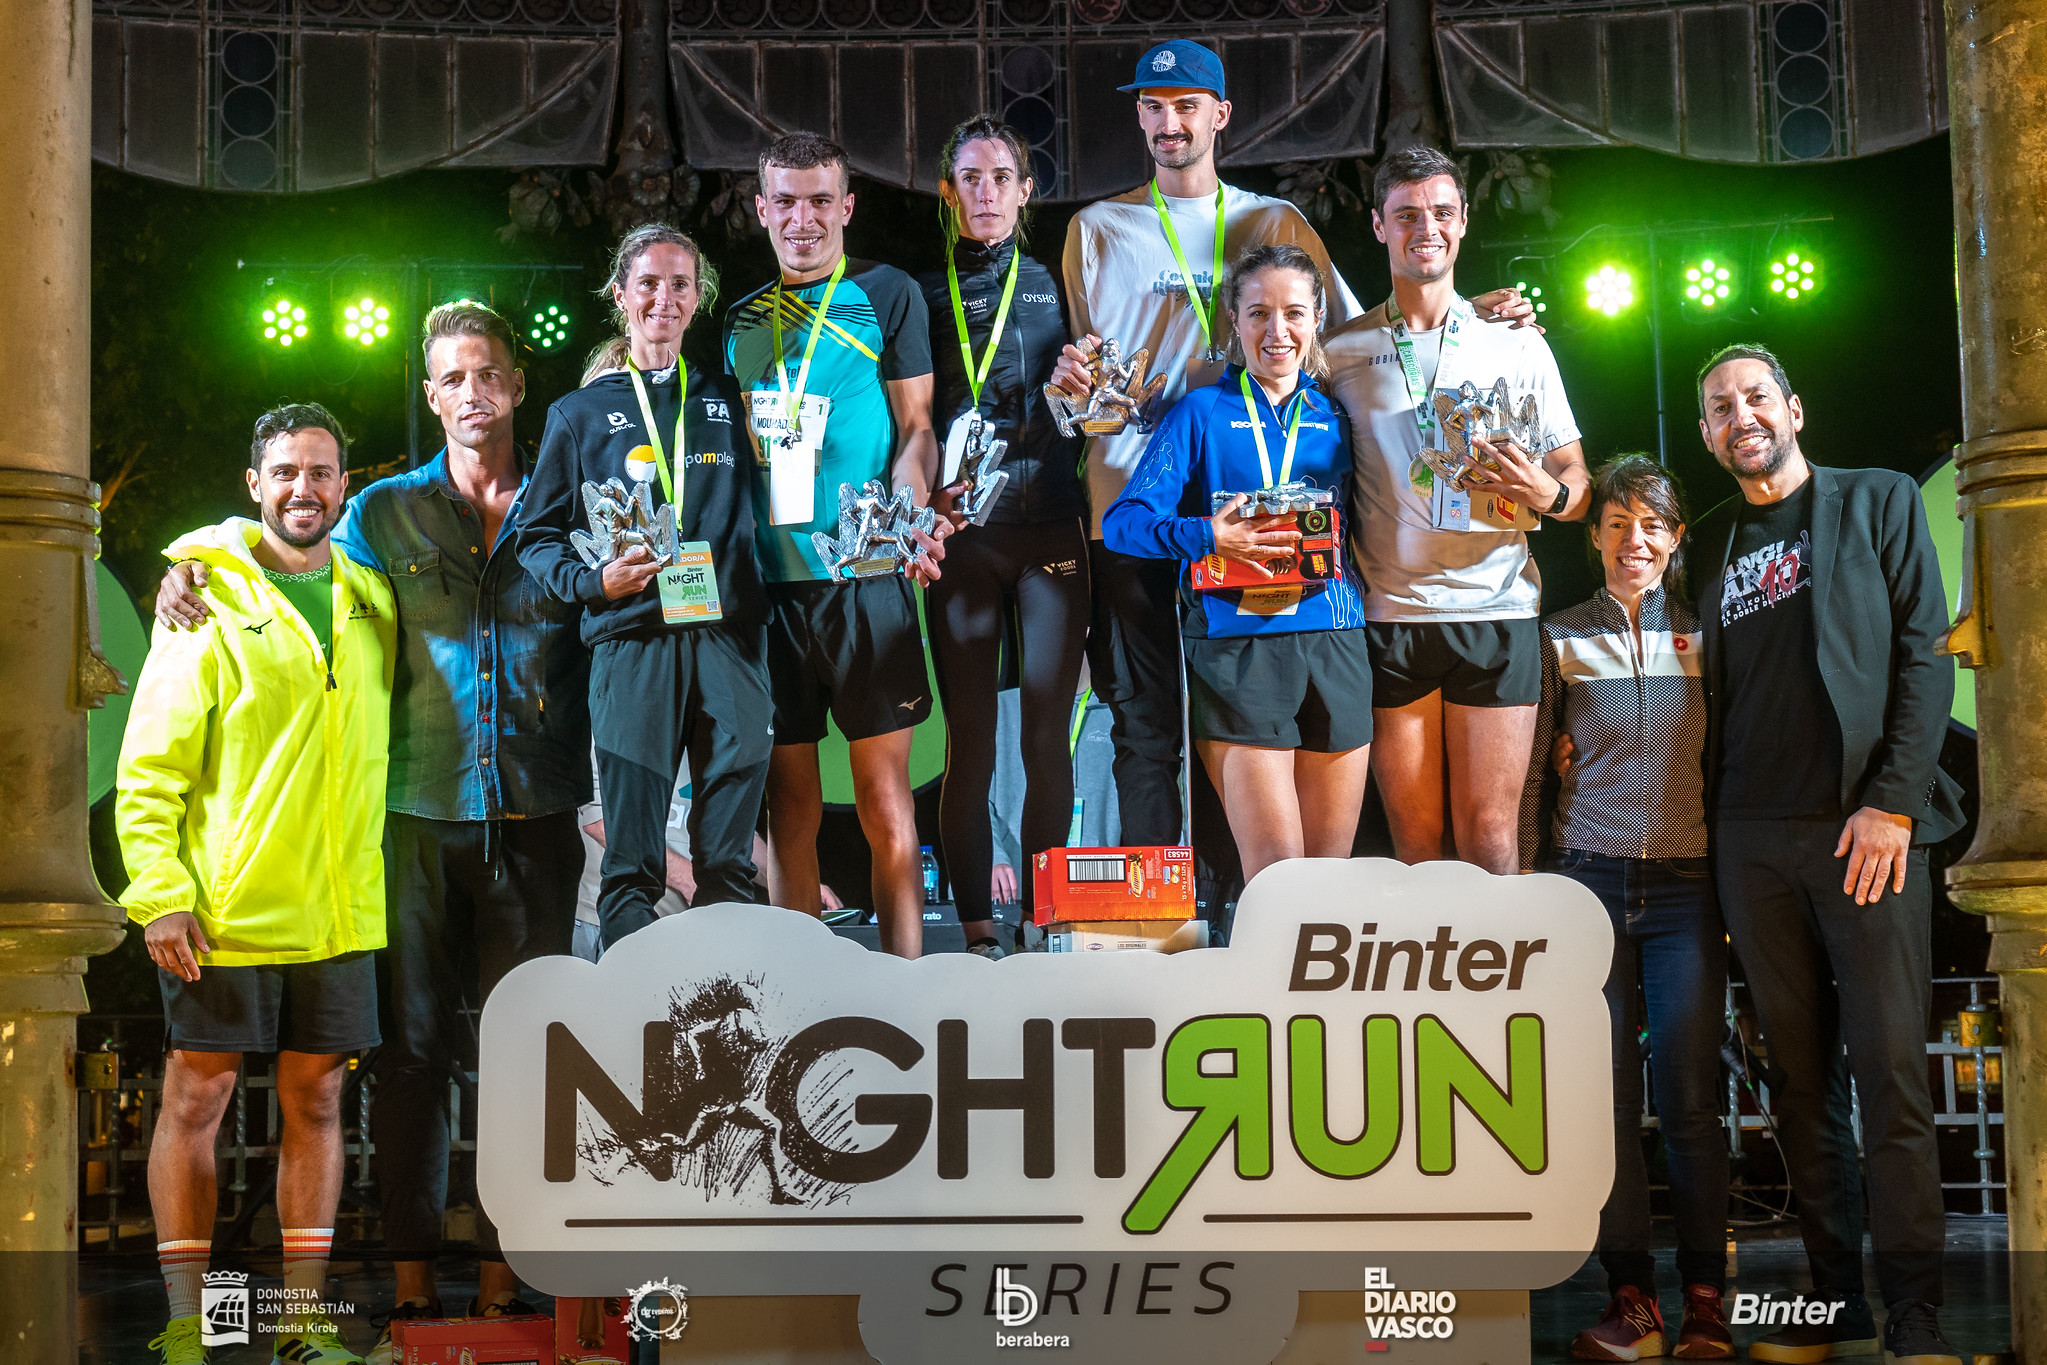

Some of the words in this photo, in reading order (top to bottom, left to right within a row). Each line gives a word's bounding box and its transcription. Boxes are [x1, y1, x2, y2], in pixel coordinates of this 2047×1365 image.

[968, 298, 987, 307] VICKY
[1022, 293, 1056, 304] OYSHO
[1057, 559, 1076, 568] VICKY
[1733, 604, 1759, 621] DOBLE
[1288, 922, 1548, 992] Binter
[1120, 1013, 1550, 1236] RUN
[925, 1262, 1235, 1317] SERIES
